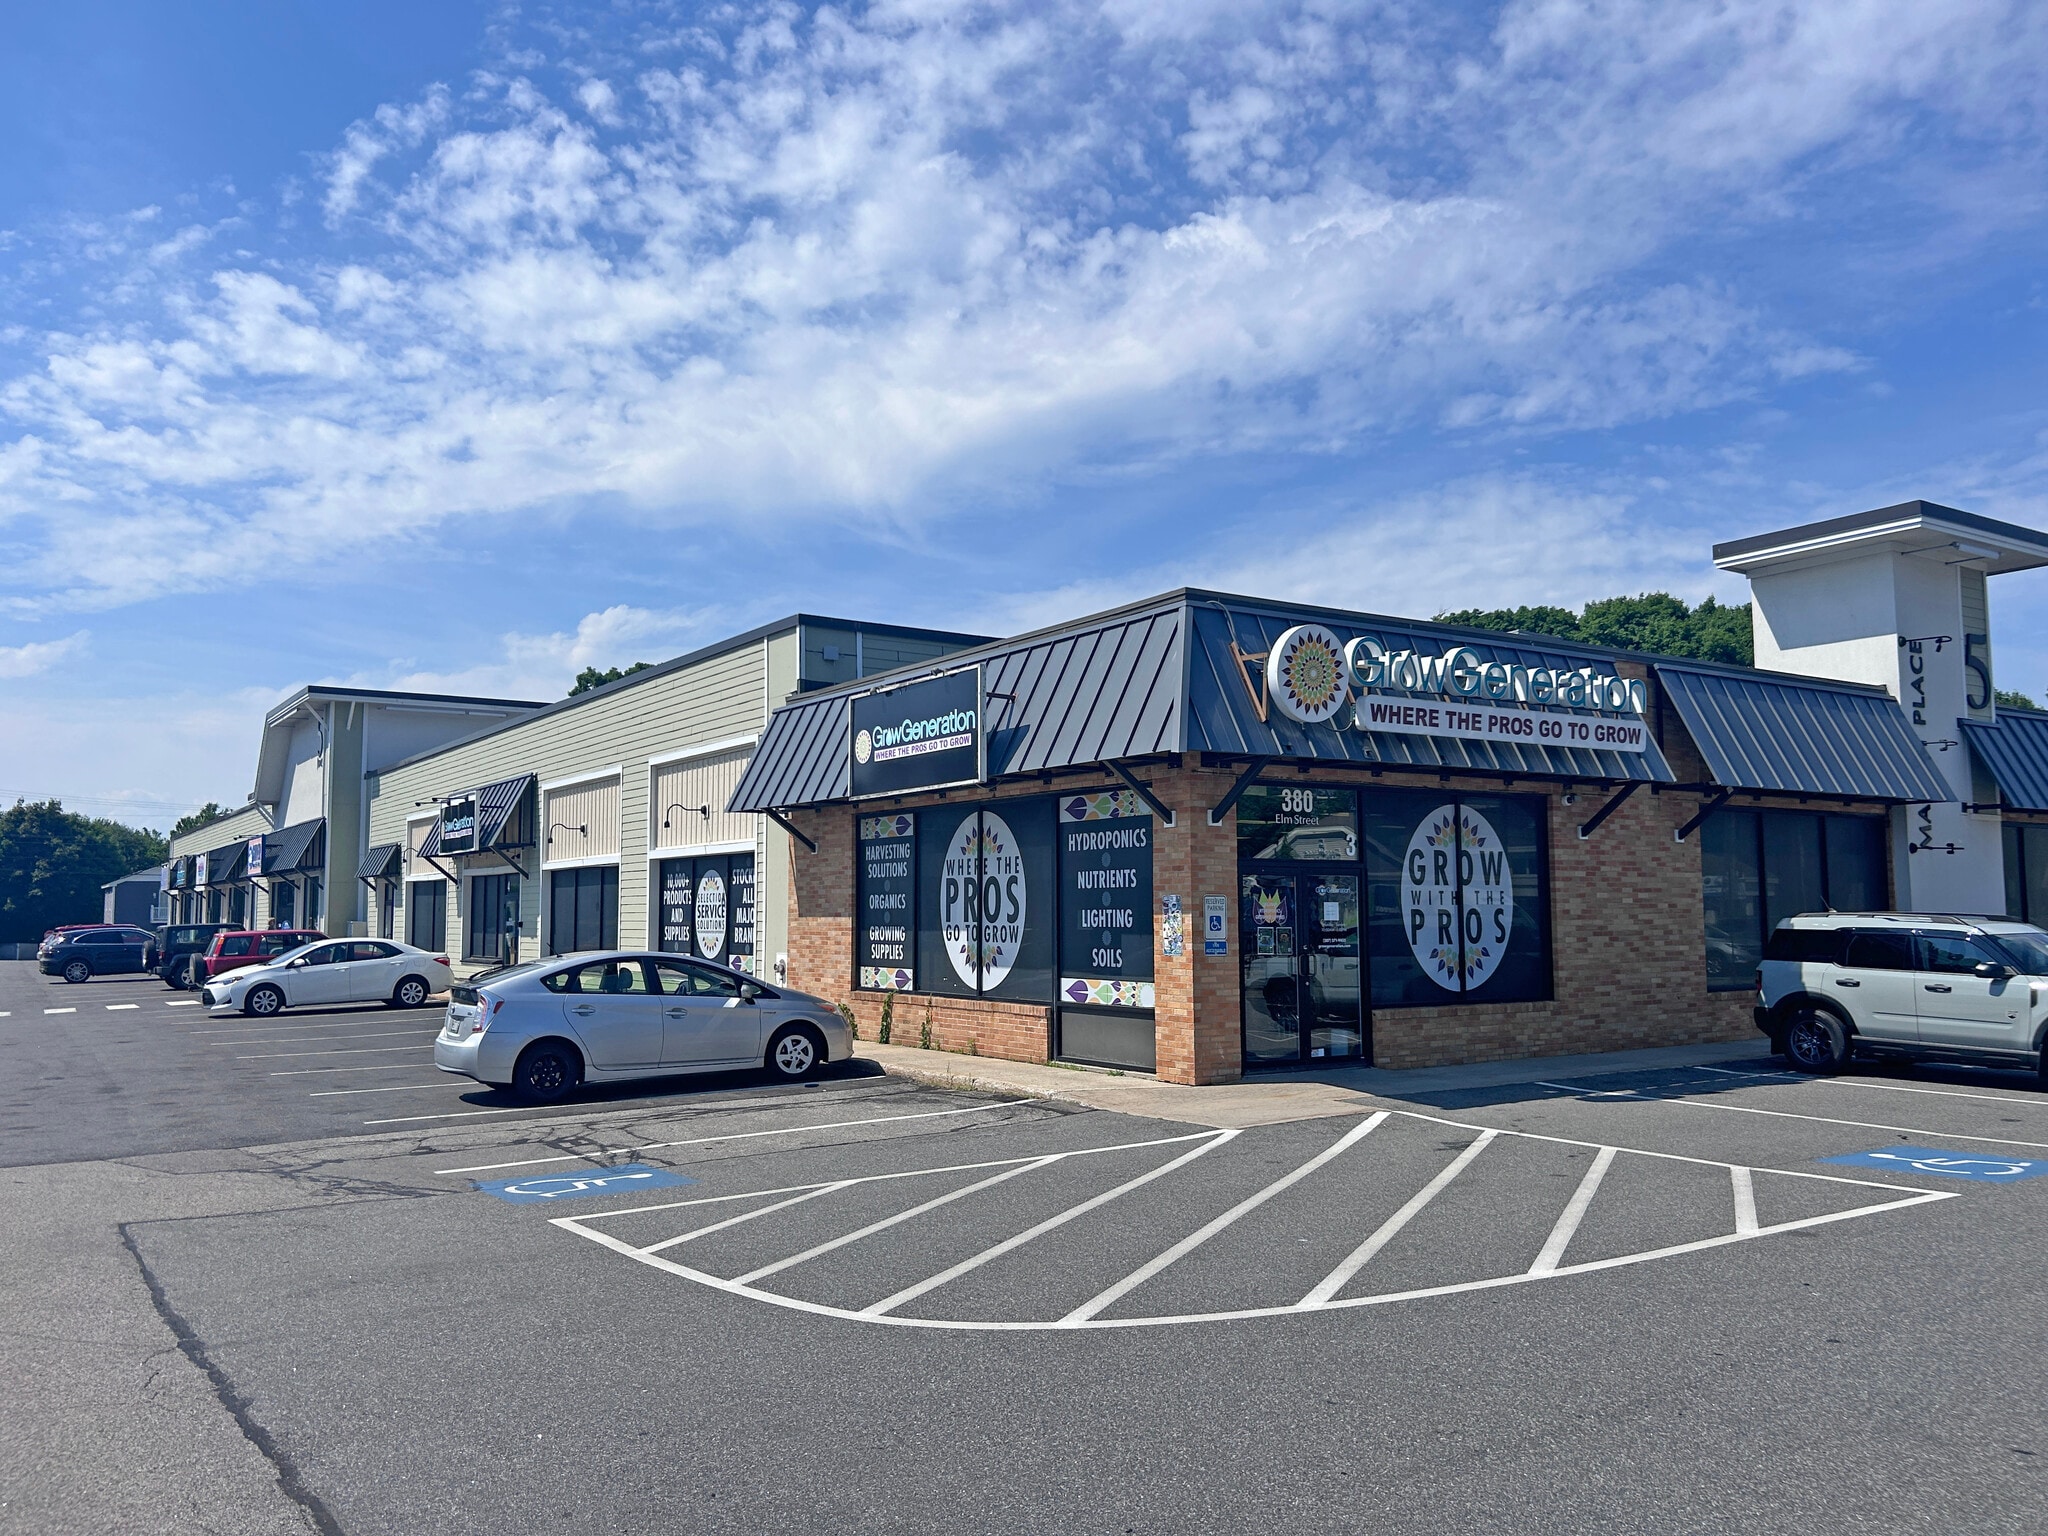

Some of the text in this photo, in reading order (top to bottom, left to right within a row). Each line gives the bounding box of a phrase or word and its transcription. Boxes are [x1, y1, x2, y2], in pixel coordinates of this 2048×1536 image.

[1344, 635, 1647, 713] GrowGeneration
[1965, 633, 1991, 710] 5
[1908, 640, 1927, 725] PLACE
[872, 709, 976, 748] GrowGeneration
[1370, 703, 1641, 745] WHERE THE PROS GO TO GROW
[875, 735, 971, 760] WHERE THE PROS GO TO GROW
[1281, 788, 1313, 813] 380
[1275, 813, 1320, 826] Elm Street
[1917, 804, 1933, 849] MA
[1068, 828, 1147, 851] HYDROPONICS
[1346, 833, 1356, 857] 3
[865, 843, 911, 860] HARVESTING
[868, 862, 908, 878] SOLUTIONS
[946, 856, 1019, 876] WHERE THE
[1408, 848, 1503, 886] GROW
[667, 873, 690, 890] 10,000+
[1078, 869, 1137, 889] NUTRIENTS
[663, 889, 692, 905] PRODUCTS
[742, 888, 754, 904] ALL
[869, 894, 906, 909] ORGANICS
[946, 875, 1019, 923] PROS
[1411, 890, 1505, 905] WITH THE
[671, 908, 684, 923] AND
[697, 904, 725, 918] SERVICE
[736, 907, 754, 924] MAJO
[1081, 909, 1133, 928] LIGHTING
[664, 926, 690, 941] SUPPLIES
[697, 920, 725, 930] SOLUTIONS
[869, 926, 906, 941] GROWING
[946, 924, 1019, 943] GO TO GROW
[1411, 908, 1506, 945] PROS
[734, 927, 753, 943] BRAN
[871, 944, 904, 960] SUPPLIES
[1092, 948, 1123, 968] SOILS
